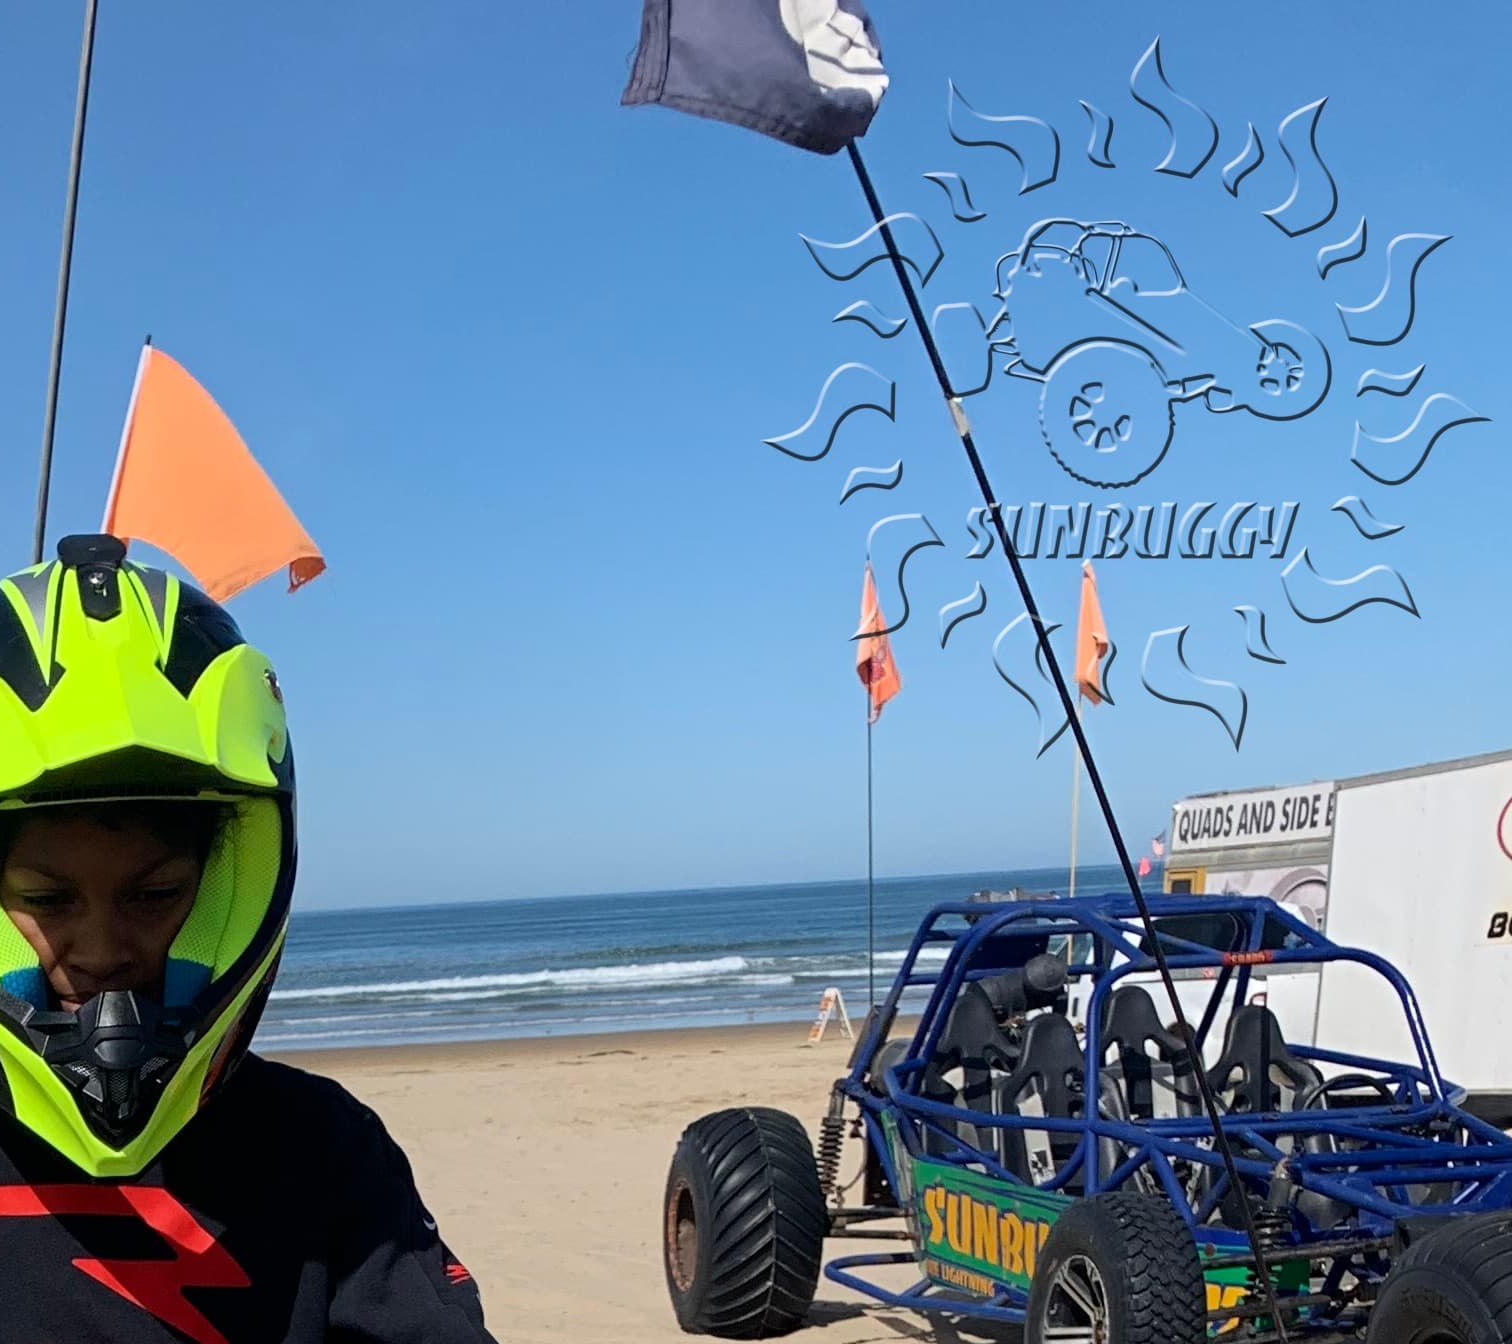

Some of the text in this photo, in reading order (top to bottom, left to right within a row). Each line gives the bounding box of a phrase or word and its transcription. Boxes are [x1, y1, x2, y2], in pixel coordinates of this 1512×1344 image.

[1178, 804, 1234, 844] QUADS
[1236, 800, 1276, 836] AND
[1280, 794, 1322, 832] SIDE
